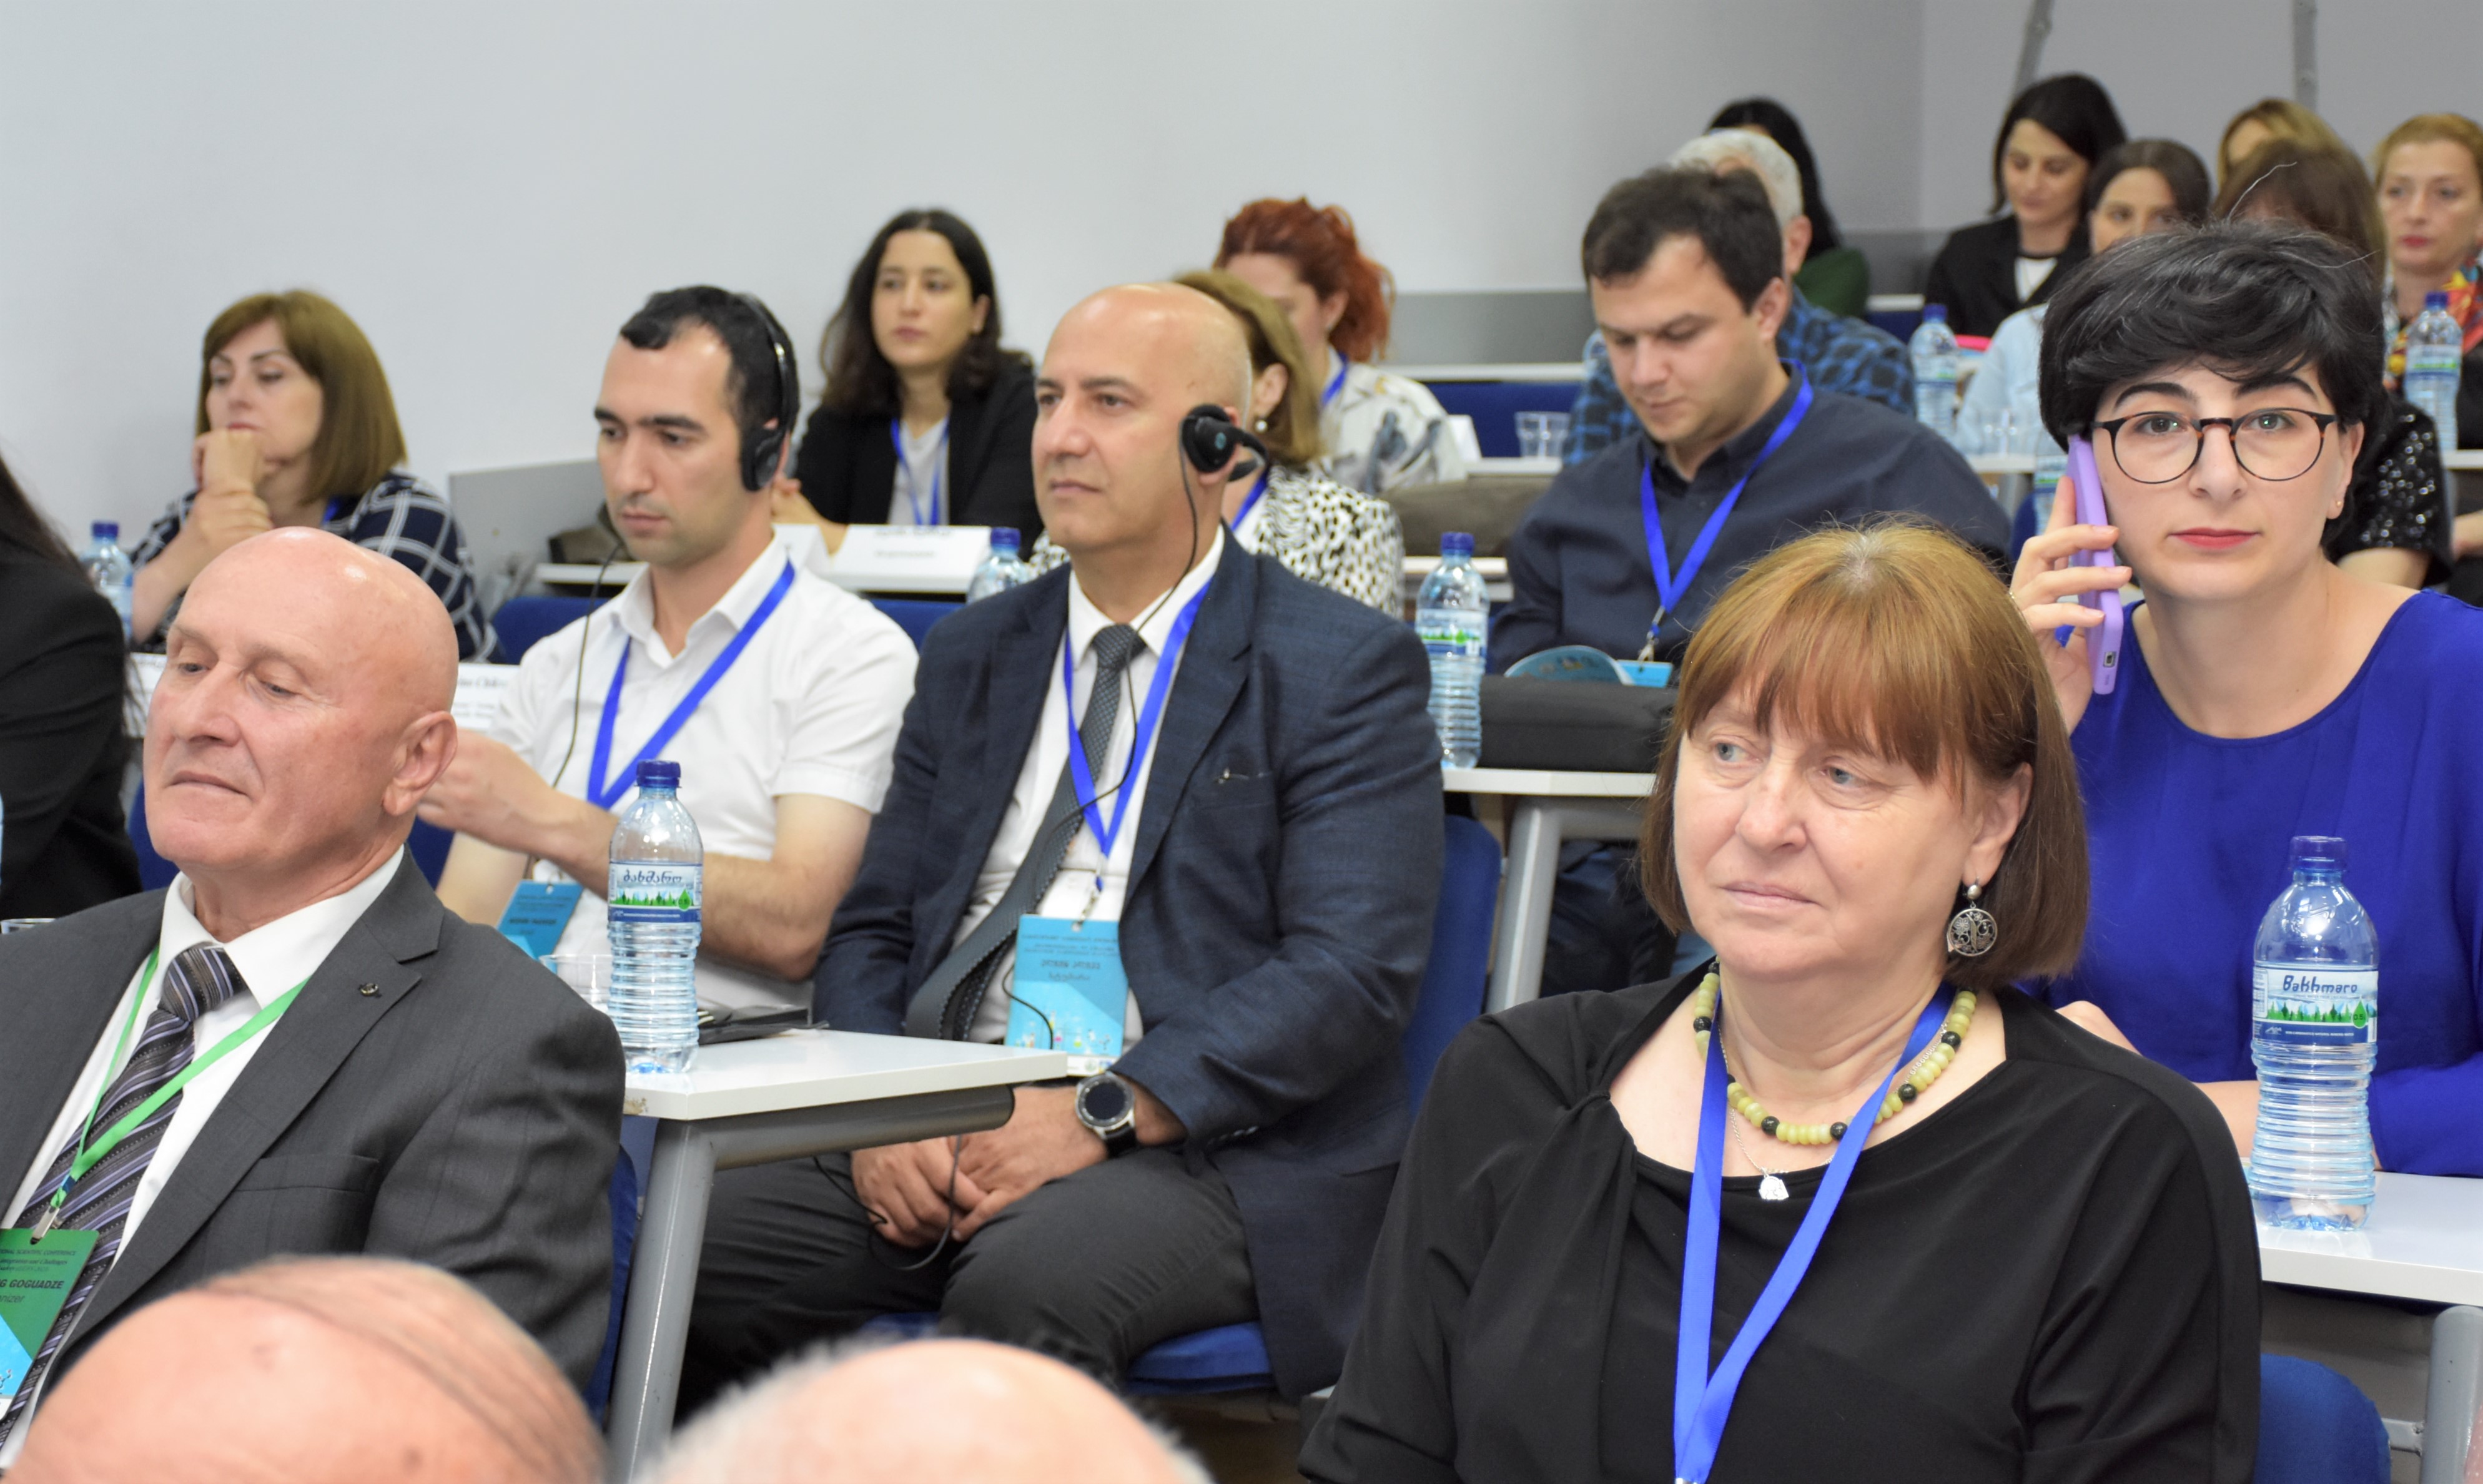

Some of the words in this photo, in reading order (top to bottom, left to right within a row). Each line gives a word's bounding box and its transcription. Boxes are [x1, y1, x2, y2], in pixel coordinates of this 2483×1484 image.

[623, 869, 682, 883] ბახმარო
[2283, 975, 2357, 993] Bakhmaro
[9, 1279, 64, 1289] GOGUADZE
